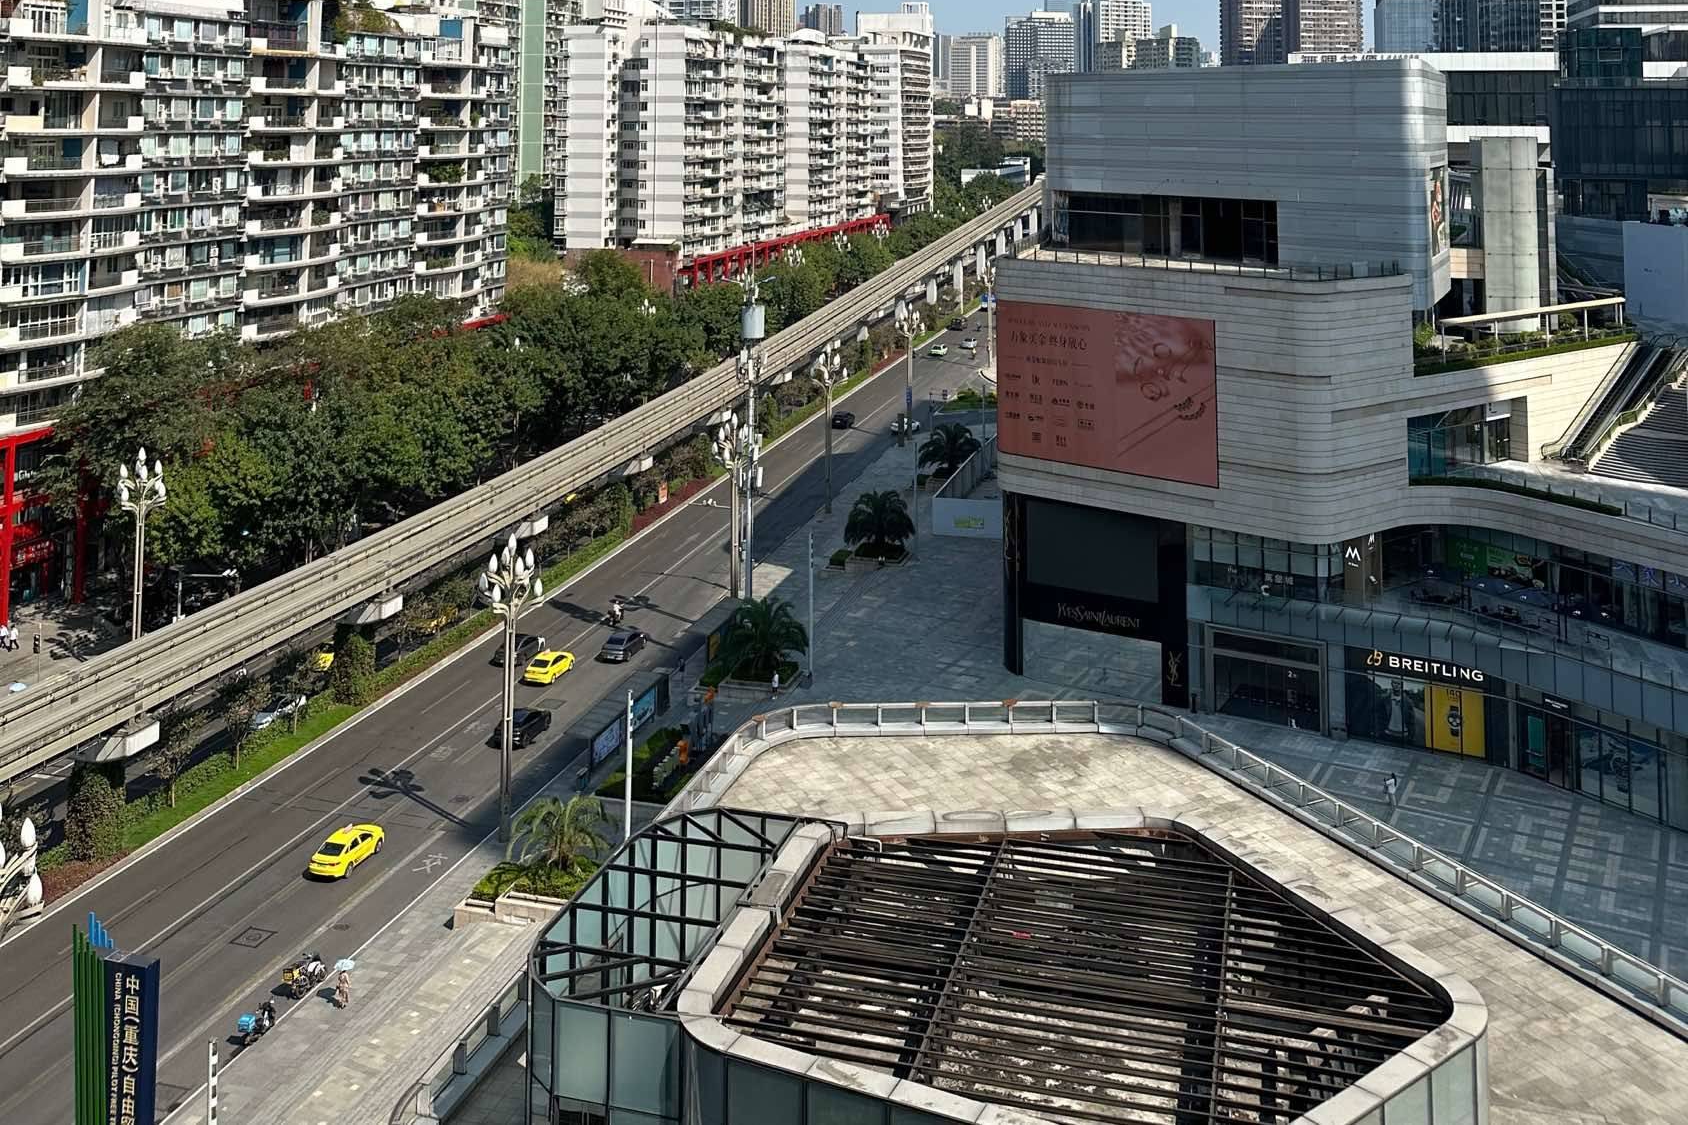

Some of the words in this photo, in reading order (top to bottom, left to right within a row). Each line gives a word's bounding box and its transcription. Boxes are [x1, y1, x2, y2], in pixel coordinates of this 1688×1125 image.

[1389, 656, 1484, 682] BREITLING
[114, 972, 122, 1001] CHINA
[111, 1003, 121, 1065] (CHONGQING)
[110, 1066, 119, 1093] PILOT
